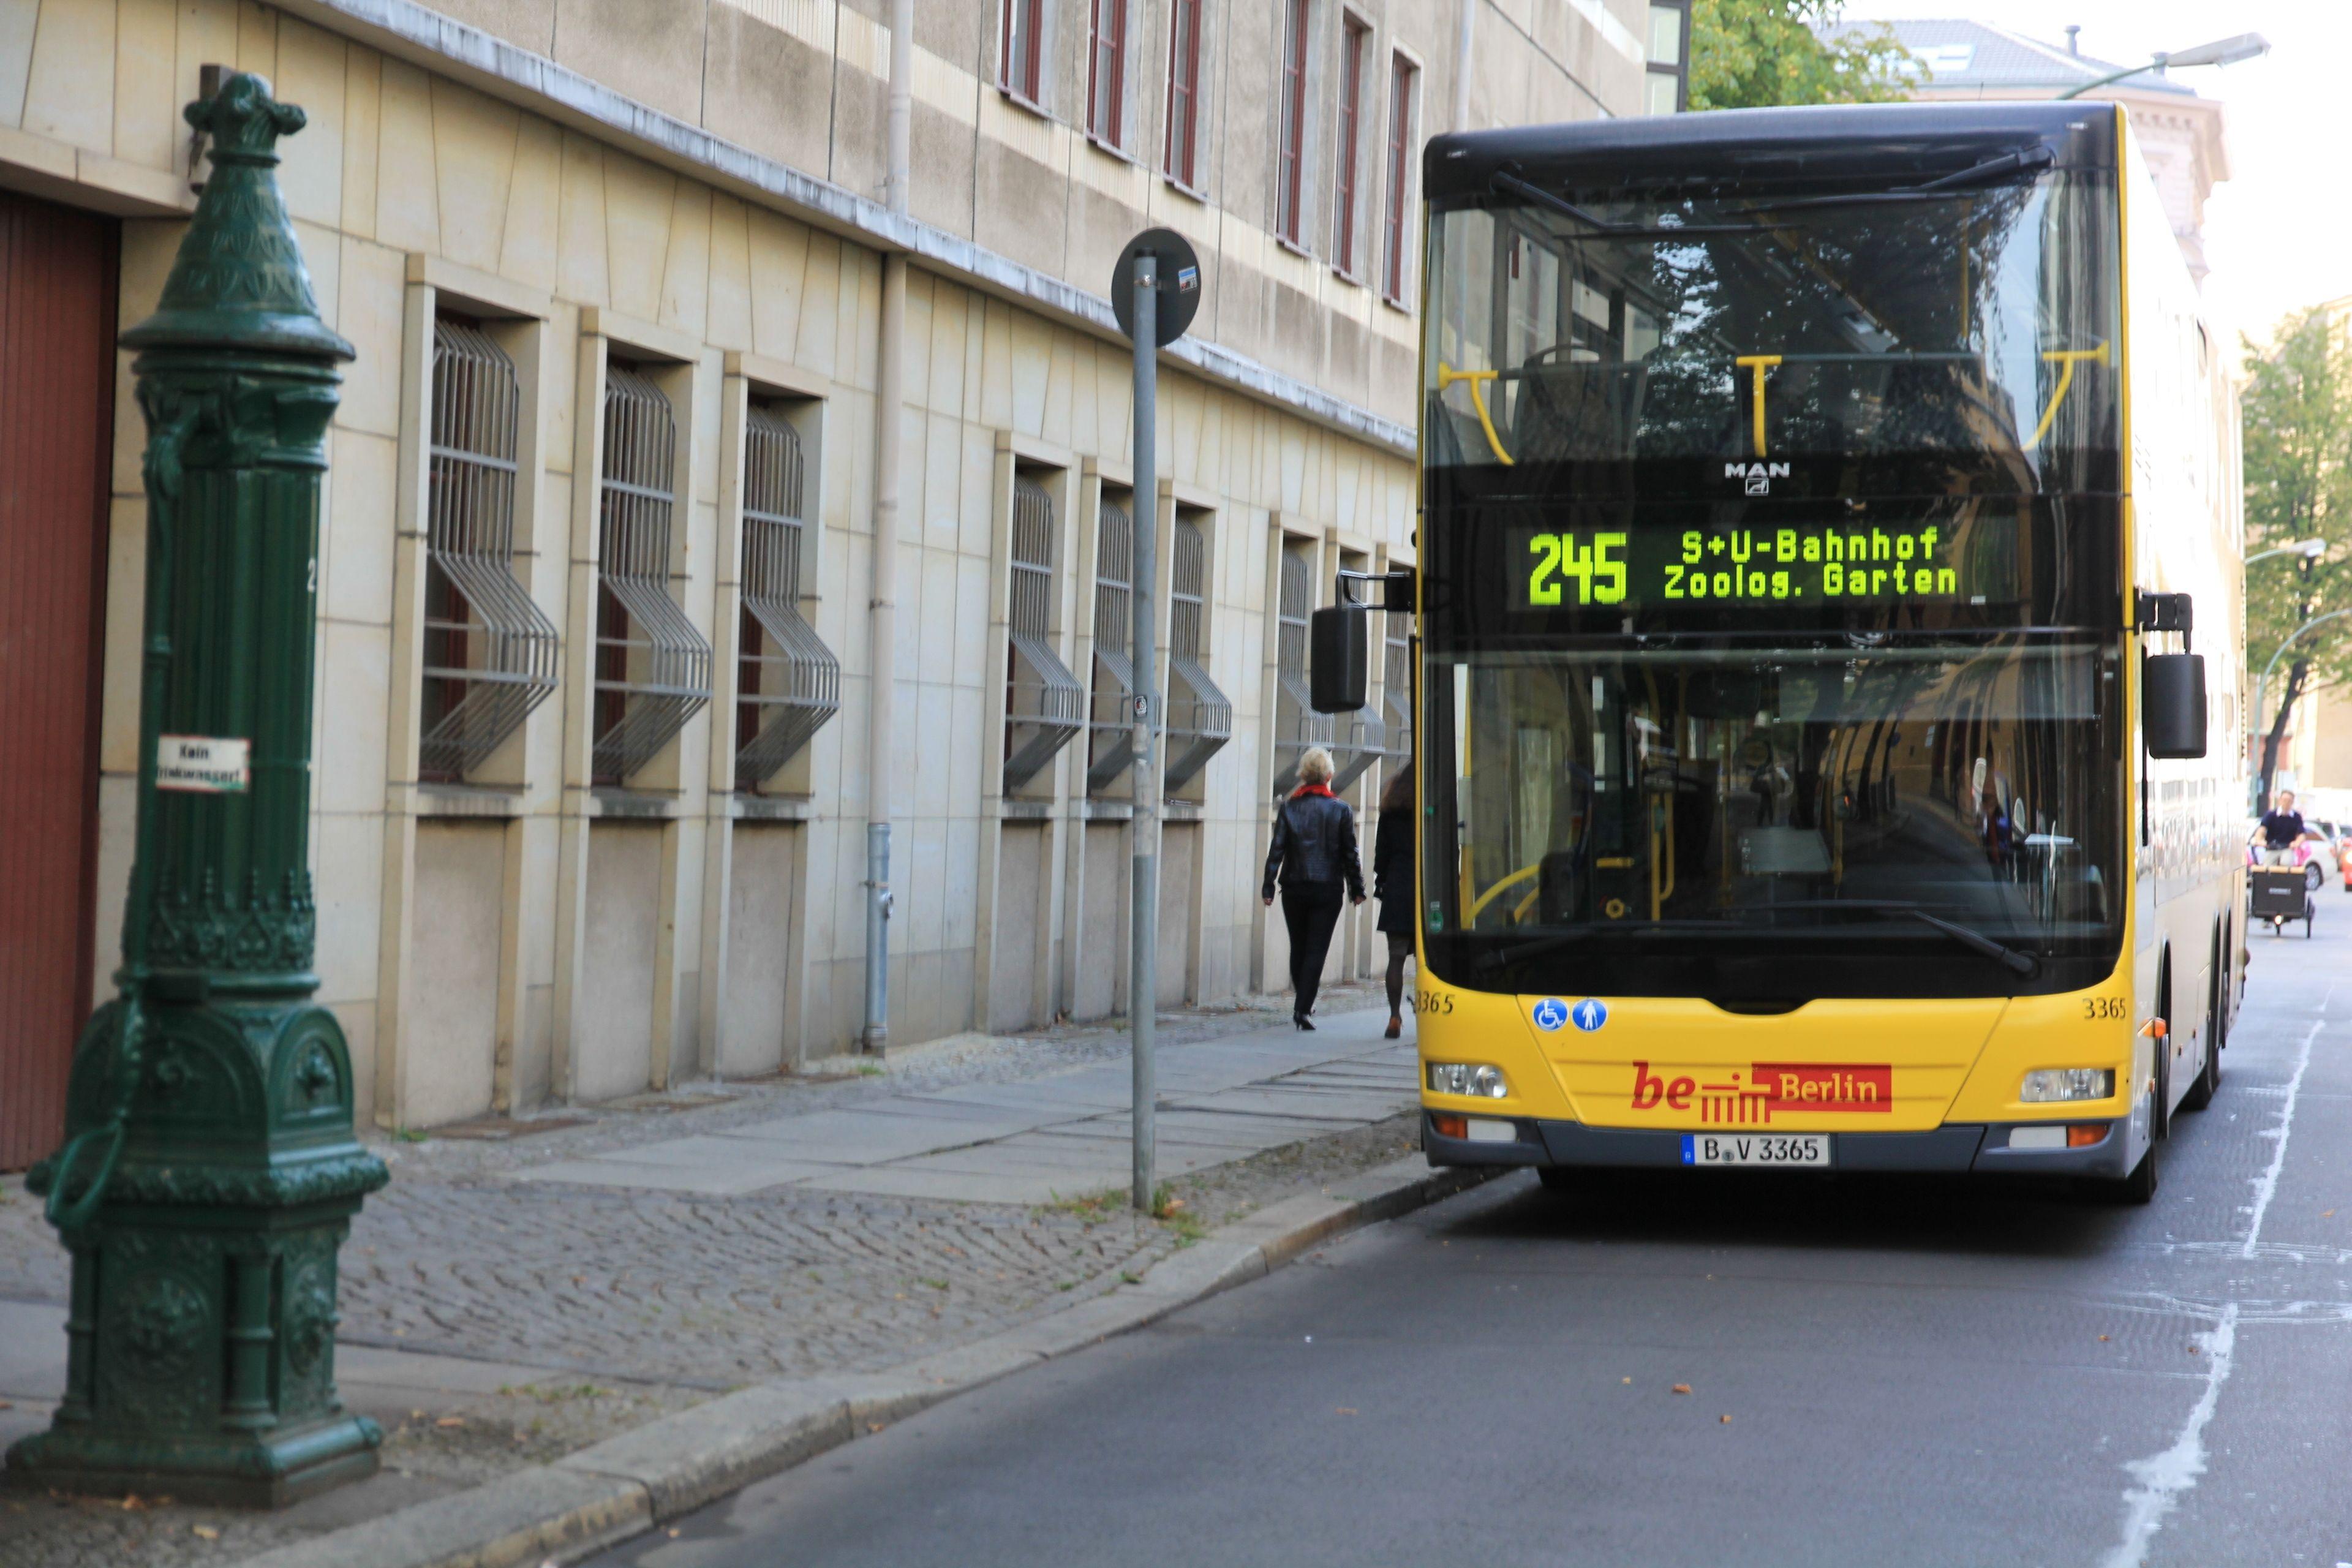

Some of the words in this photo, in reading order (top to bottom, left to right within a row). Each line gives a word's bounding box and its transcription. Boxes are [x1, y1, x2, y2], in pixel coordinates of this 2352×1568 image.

[1725, 462, 1790, 478] MAN
[1682, 526, 1938, 563] S+U-Bahnhof
[1529, 532, 1627, 605] 245
[1664, 564, 1802, 599] Zoolog.
[1823, 561, 1956, 596] Garten
[2084, 997, 2126, 1019] 3365
[1631, 1060, 1696, 1110] be
[1779, 1072, 1877, 1103] Berlin
[1705, 1138, 1719, 1160] B
[1737, 1138, 1751, 1160] V
[1759, 1138, 1819, 1161] 3365
